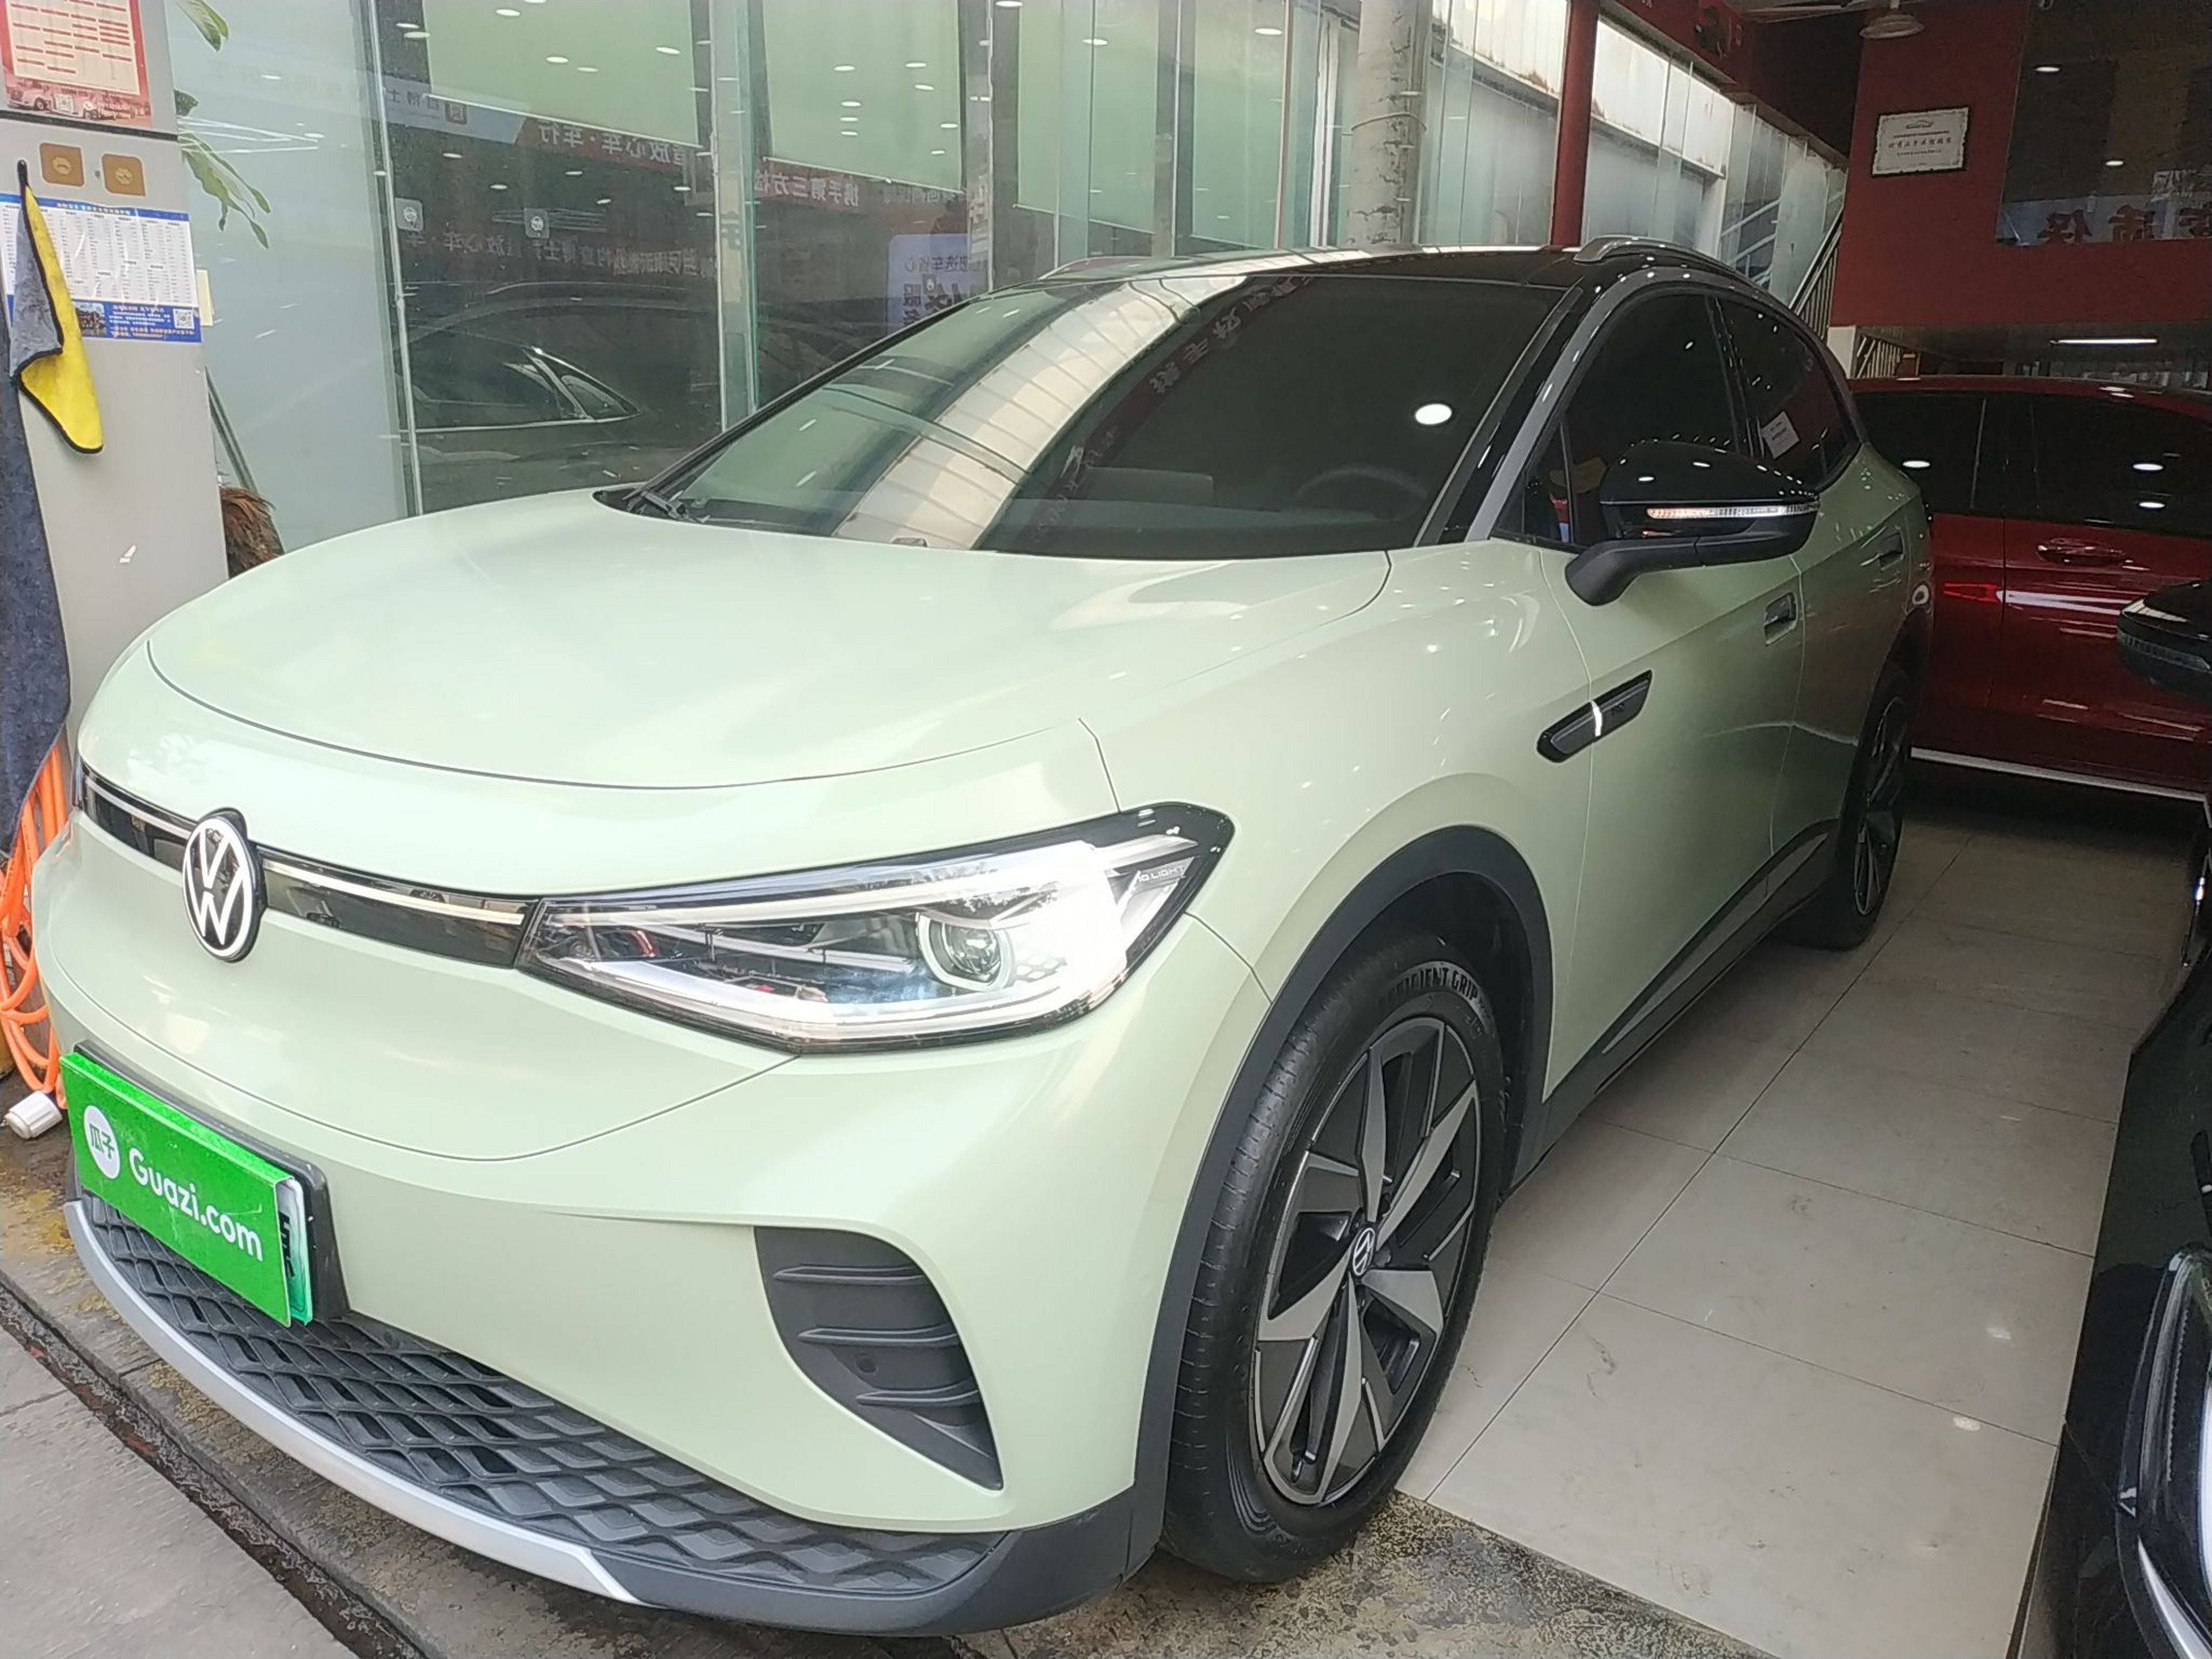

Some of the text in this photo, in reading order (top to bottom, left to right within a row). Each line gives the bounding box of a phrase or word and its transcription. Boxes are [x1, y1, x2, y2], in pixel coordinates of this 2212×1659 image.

[1451, 969, 1478, 1001] GRIP
[89, 1123, 115, 1160] 瓜子
[128, 1146, 264, 1263] Guazi.com
